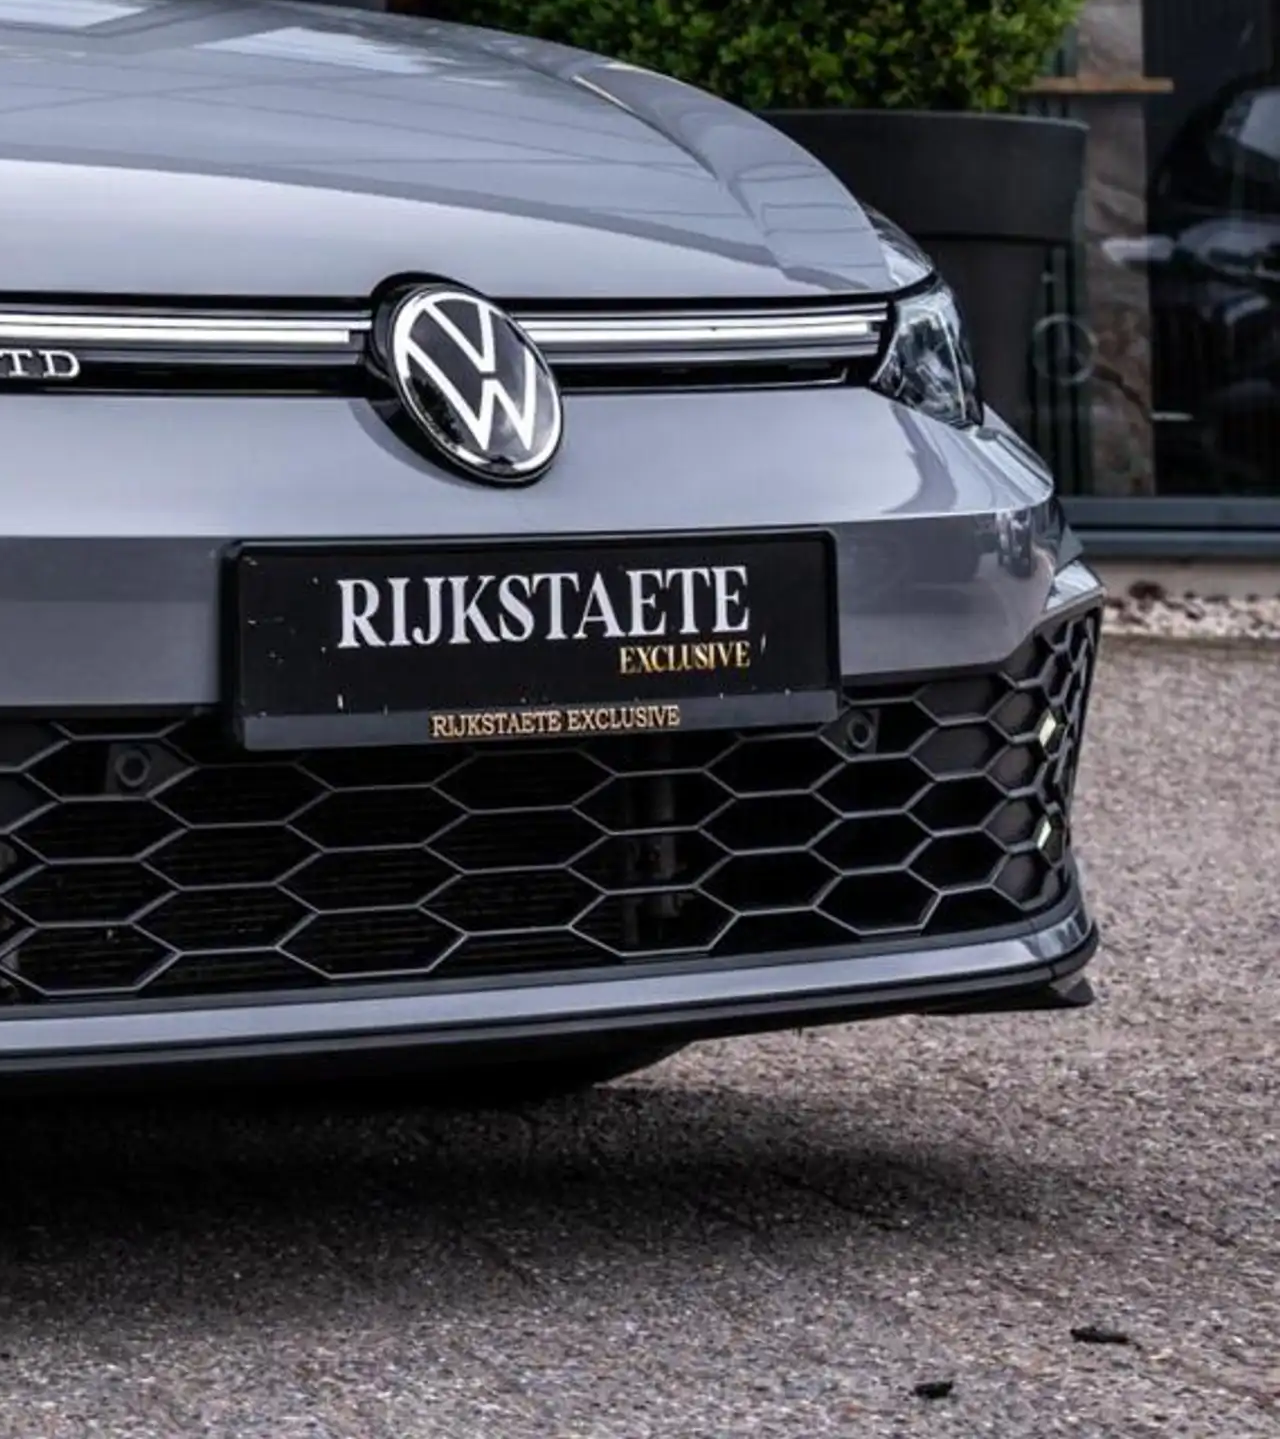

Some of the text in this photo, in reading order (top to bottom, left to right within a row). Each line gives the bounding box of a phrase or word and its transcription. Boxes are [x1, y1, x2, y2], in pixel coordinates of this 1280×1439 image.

[336, 564, 750, 650] RIJKSTAETE
[618, 639, 751, 675] EXCLUSIVE
[431, 703, 681, 739] RIJKSTAETE EXCLUSIVE
